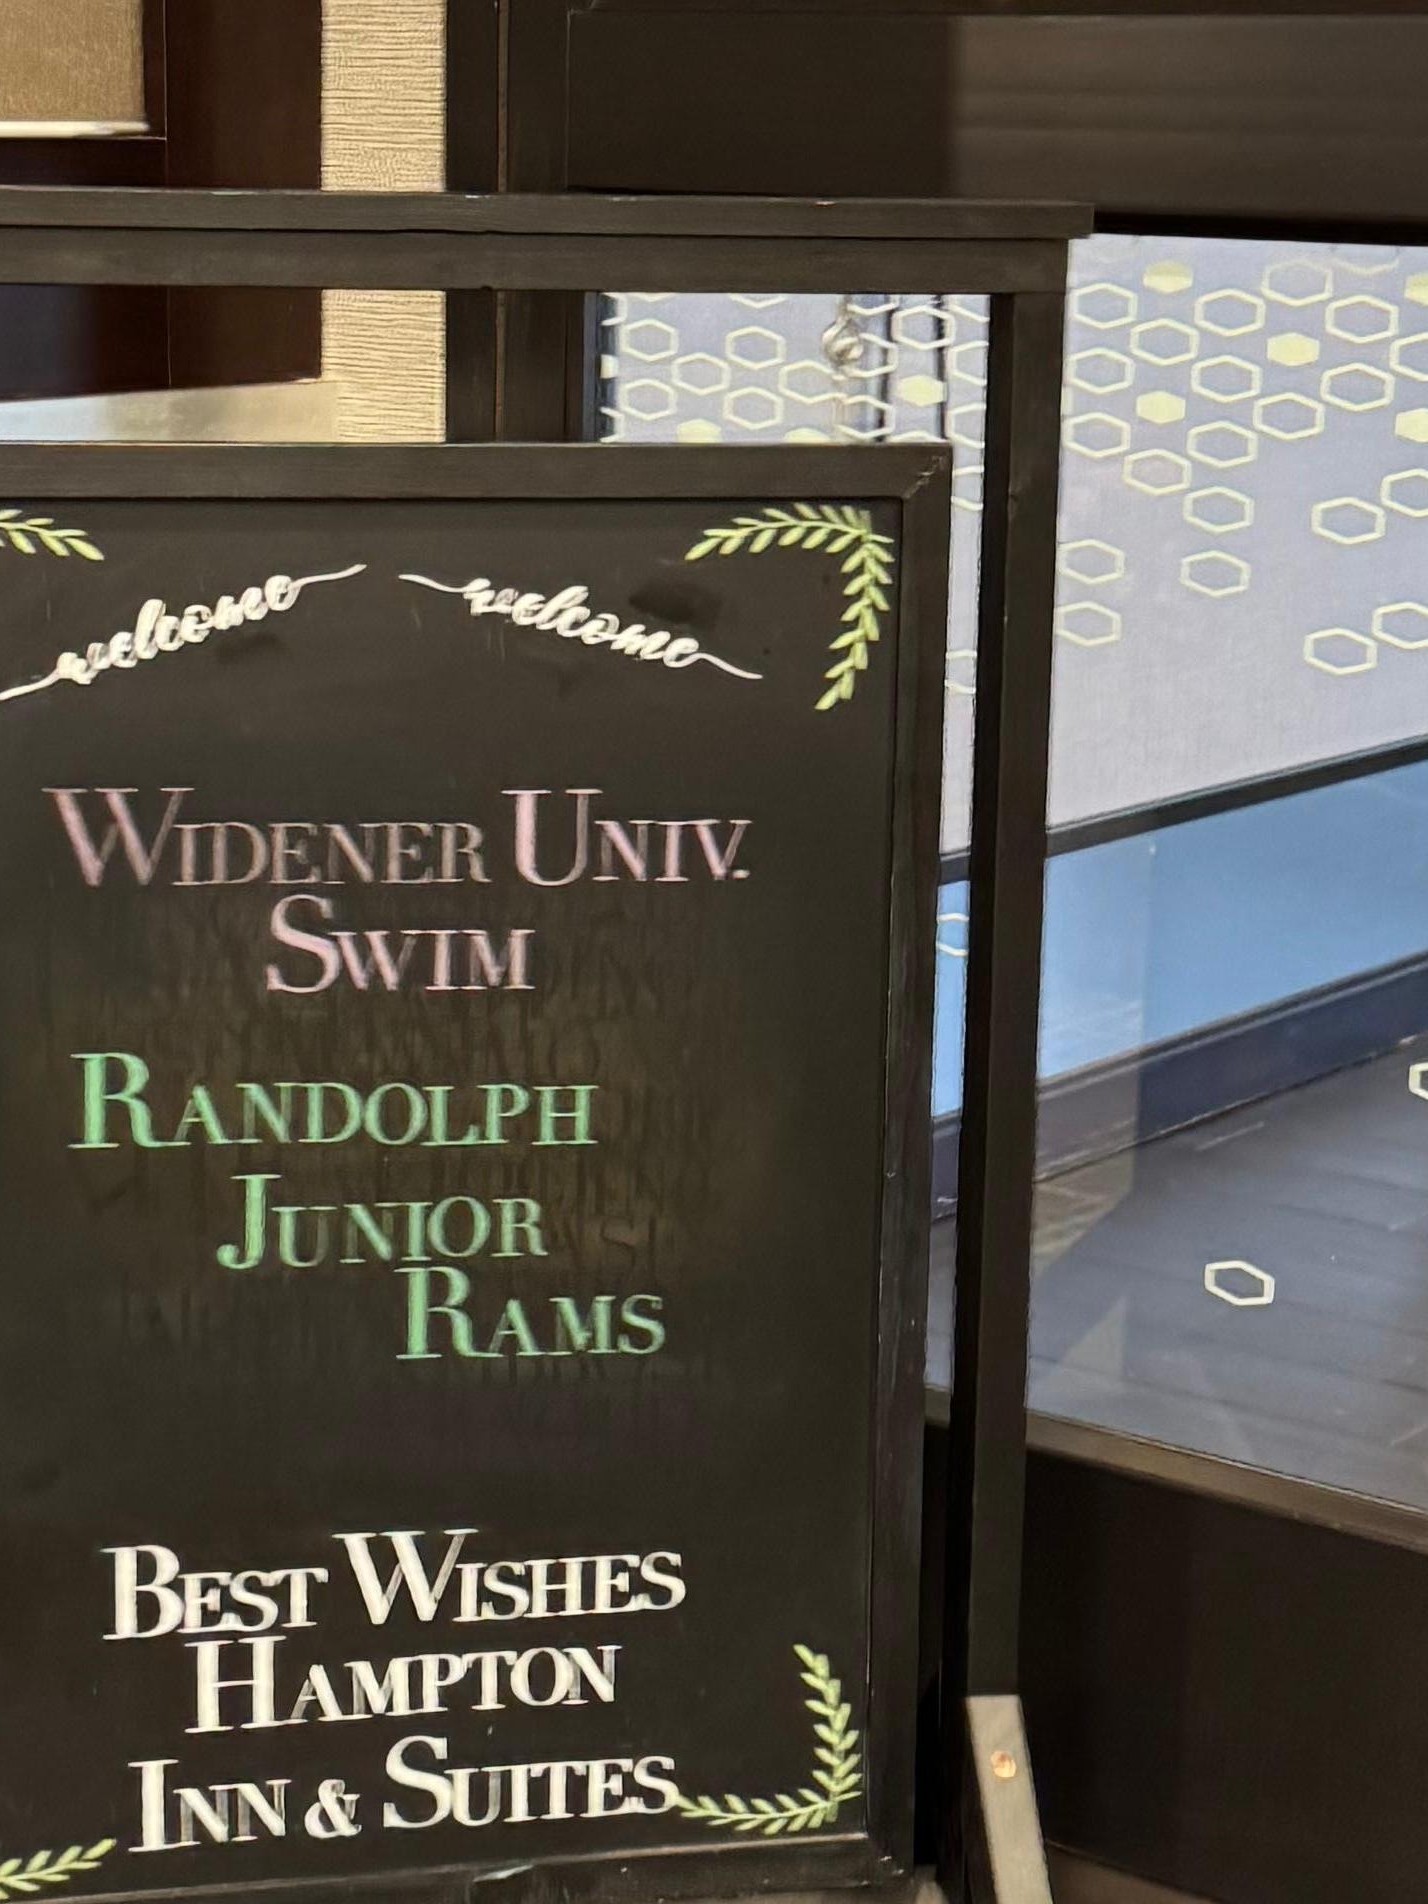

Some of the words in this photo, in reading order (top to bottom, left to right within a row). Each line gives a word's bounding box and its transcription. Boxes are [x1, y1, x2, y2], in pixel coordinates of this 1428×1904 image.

[398, 572, 763, 679] welcome
[41, 788, 492, 886] WIDENER
[501, 788, 752, 886] UNIV.
[263, 894, 535, 993] SWIM
[68, 1052, 599, 1148] RANDOLPH
[216, 1174, 548, 1270] JUNIOR
[394, 1266, 664, 1359] RAMS
[101, 1545, 328, 1641] BEST
[332, 1528, 686, 1624] WISHES
[183, 1634, 622, 1734] HAMPTON
[127, 1759, 291, 1852] INN
[304, 1779, 362, 1839] &
[383, 1735, 678, 1828] SUITES
